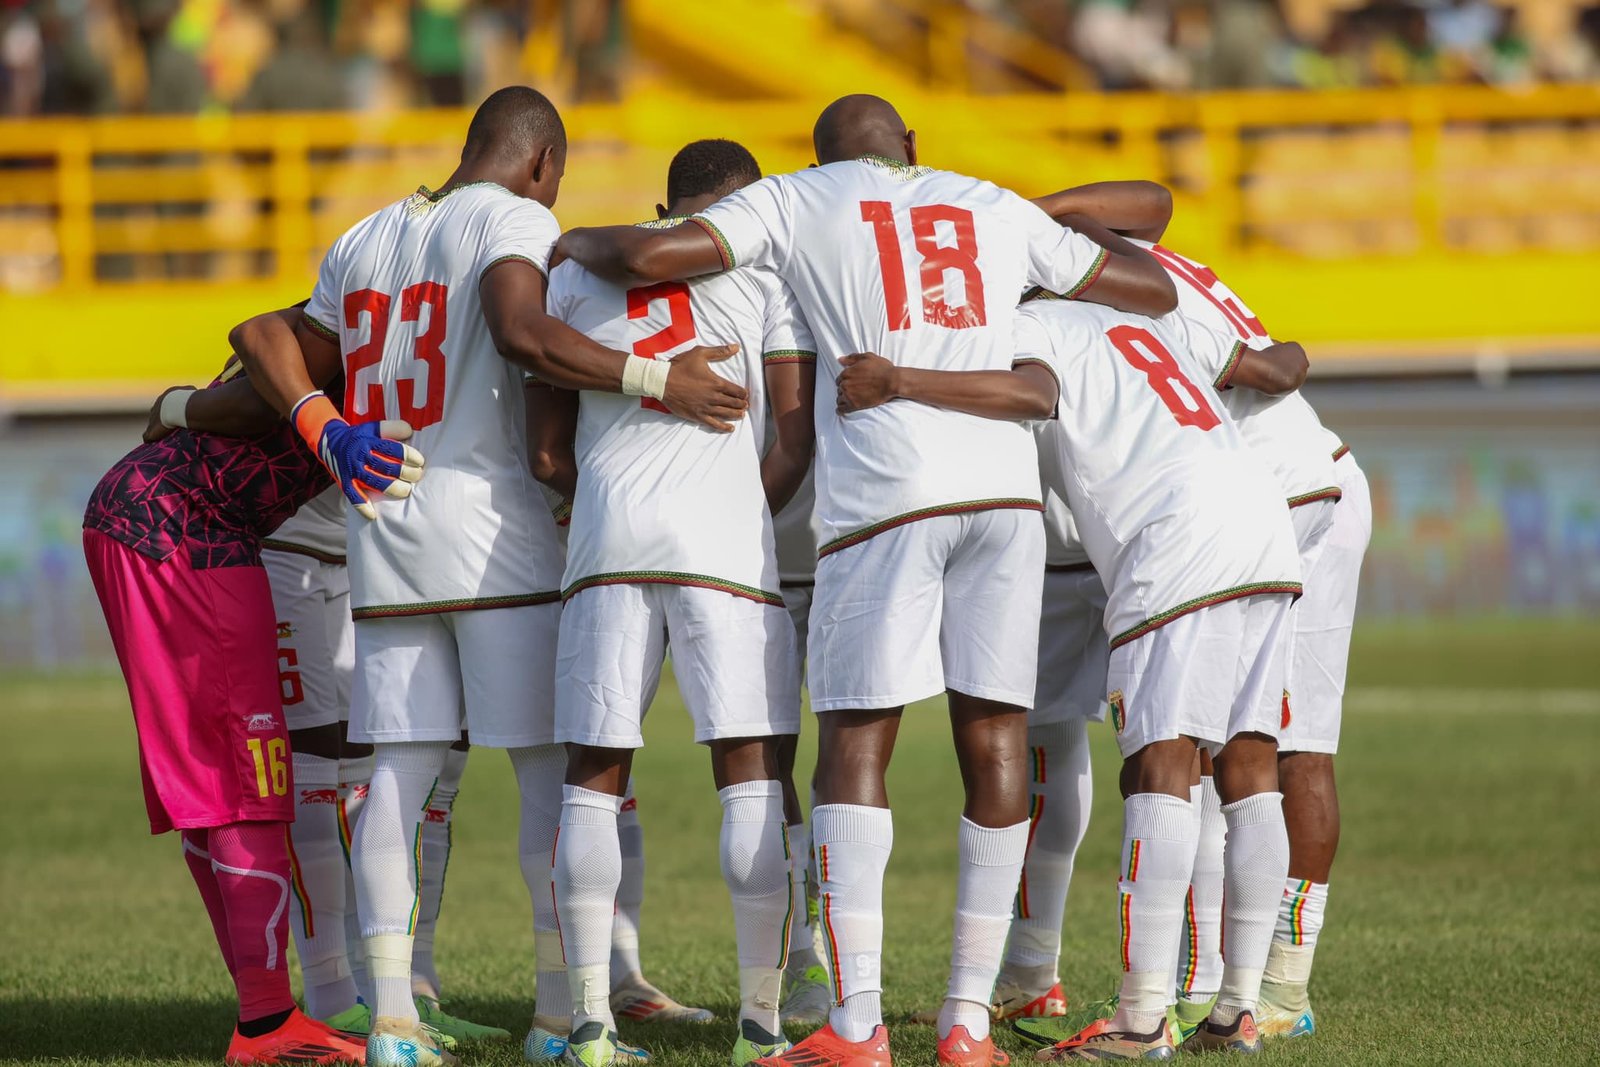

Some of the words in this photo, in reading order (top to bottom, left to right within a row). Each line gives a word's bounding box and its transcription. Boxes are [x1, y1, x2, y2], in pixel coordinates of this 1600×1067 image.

[860, 201, 987, 331] 18
[343, 281, 448, 431] 23
[626, 282, 697, 415] 2
[1106, 325, 1222, 431] 8
[277, 647, 304, 705] 6
[247, 737, 288, 798] 16
